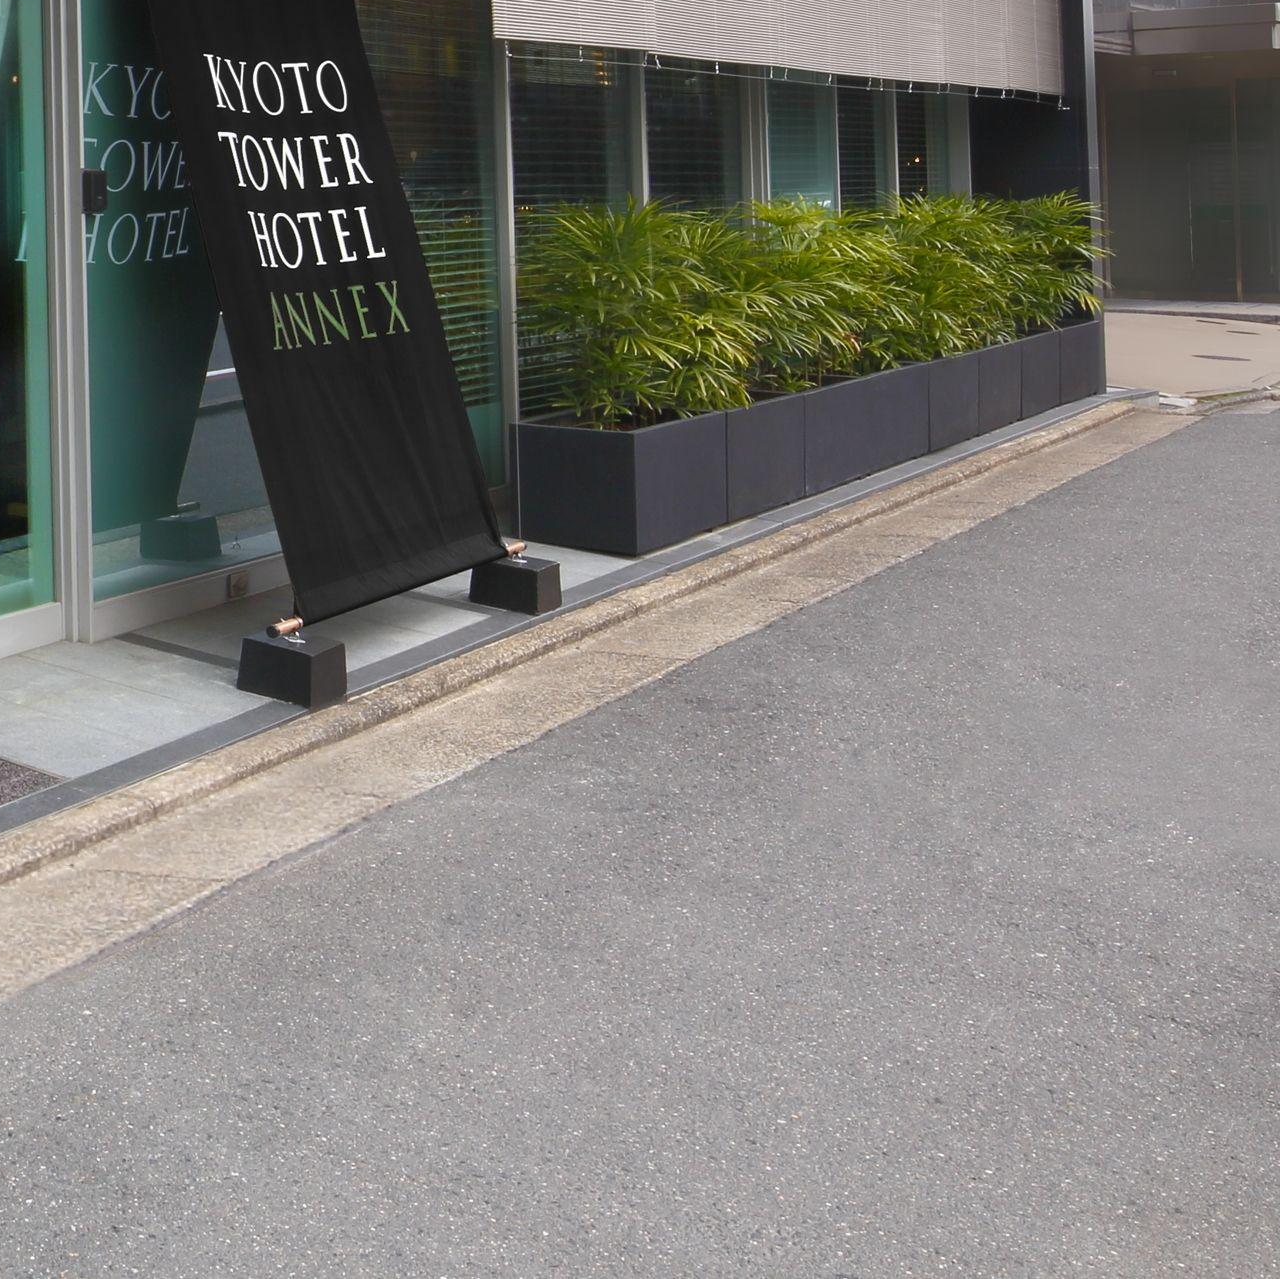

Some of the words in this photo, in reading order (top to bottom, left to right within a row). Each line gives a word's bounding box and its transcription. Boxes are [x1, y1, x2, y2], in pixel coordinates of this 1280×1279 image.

[203, 53, 348, 116] KYOTO
[217, 131, 374, 192] TOWER
[247, 206, 387, 269] HOTEL
[270, 280, 411, 351] ANNEX
